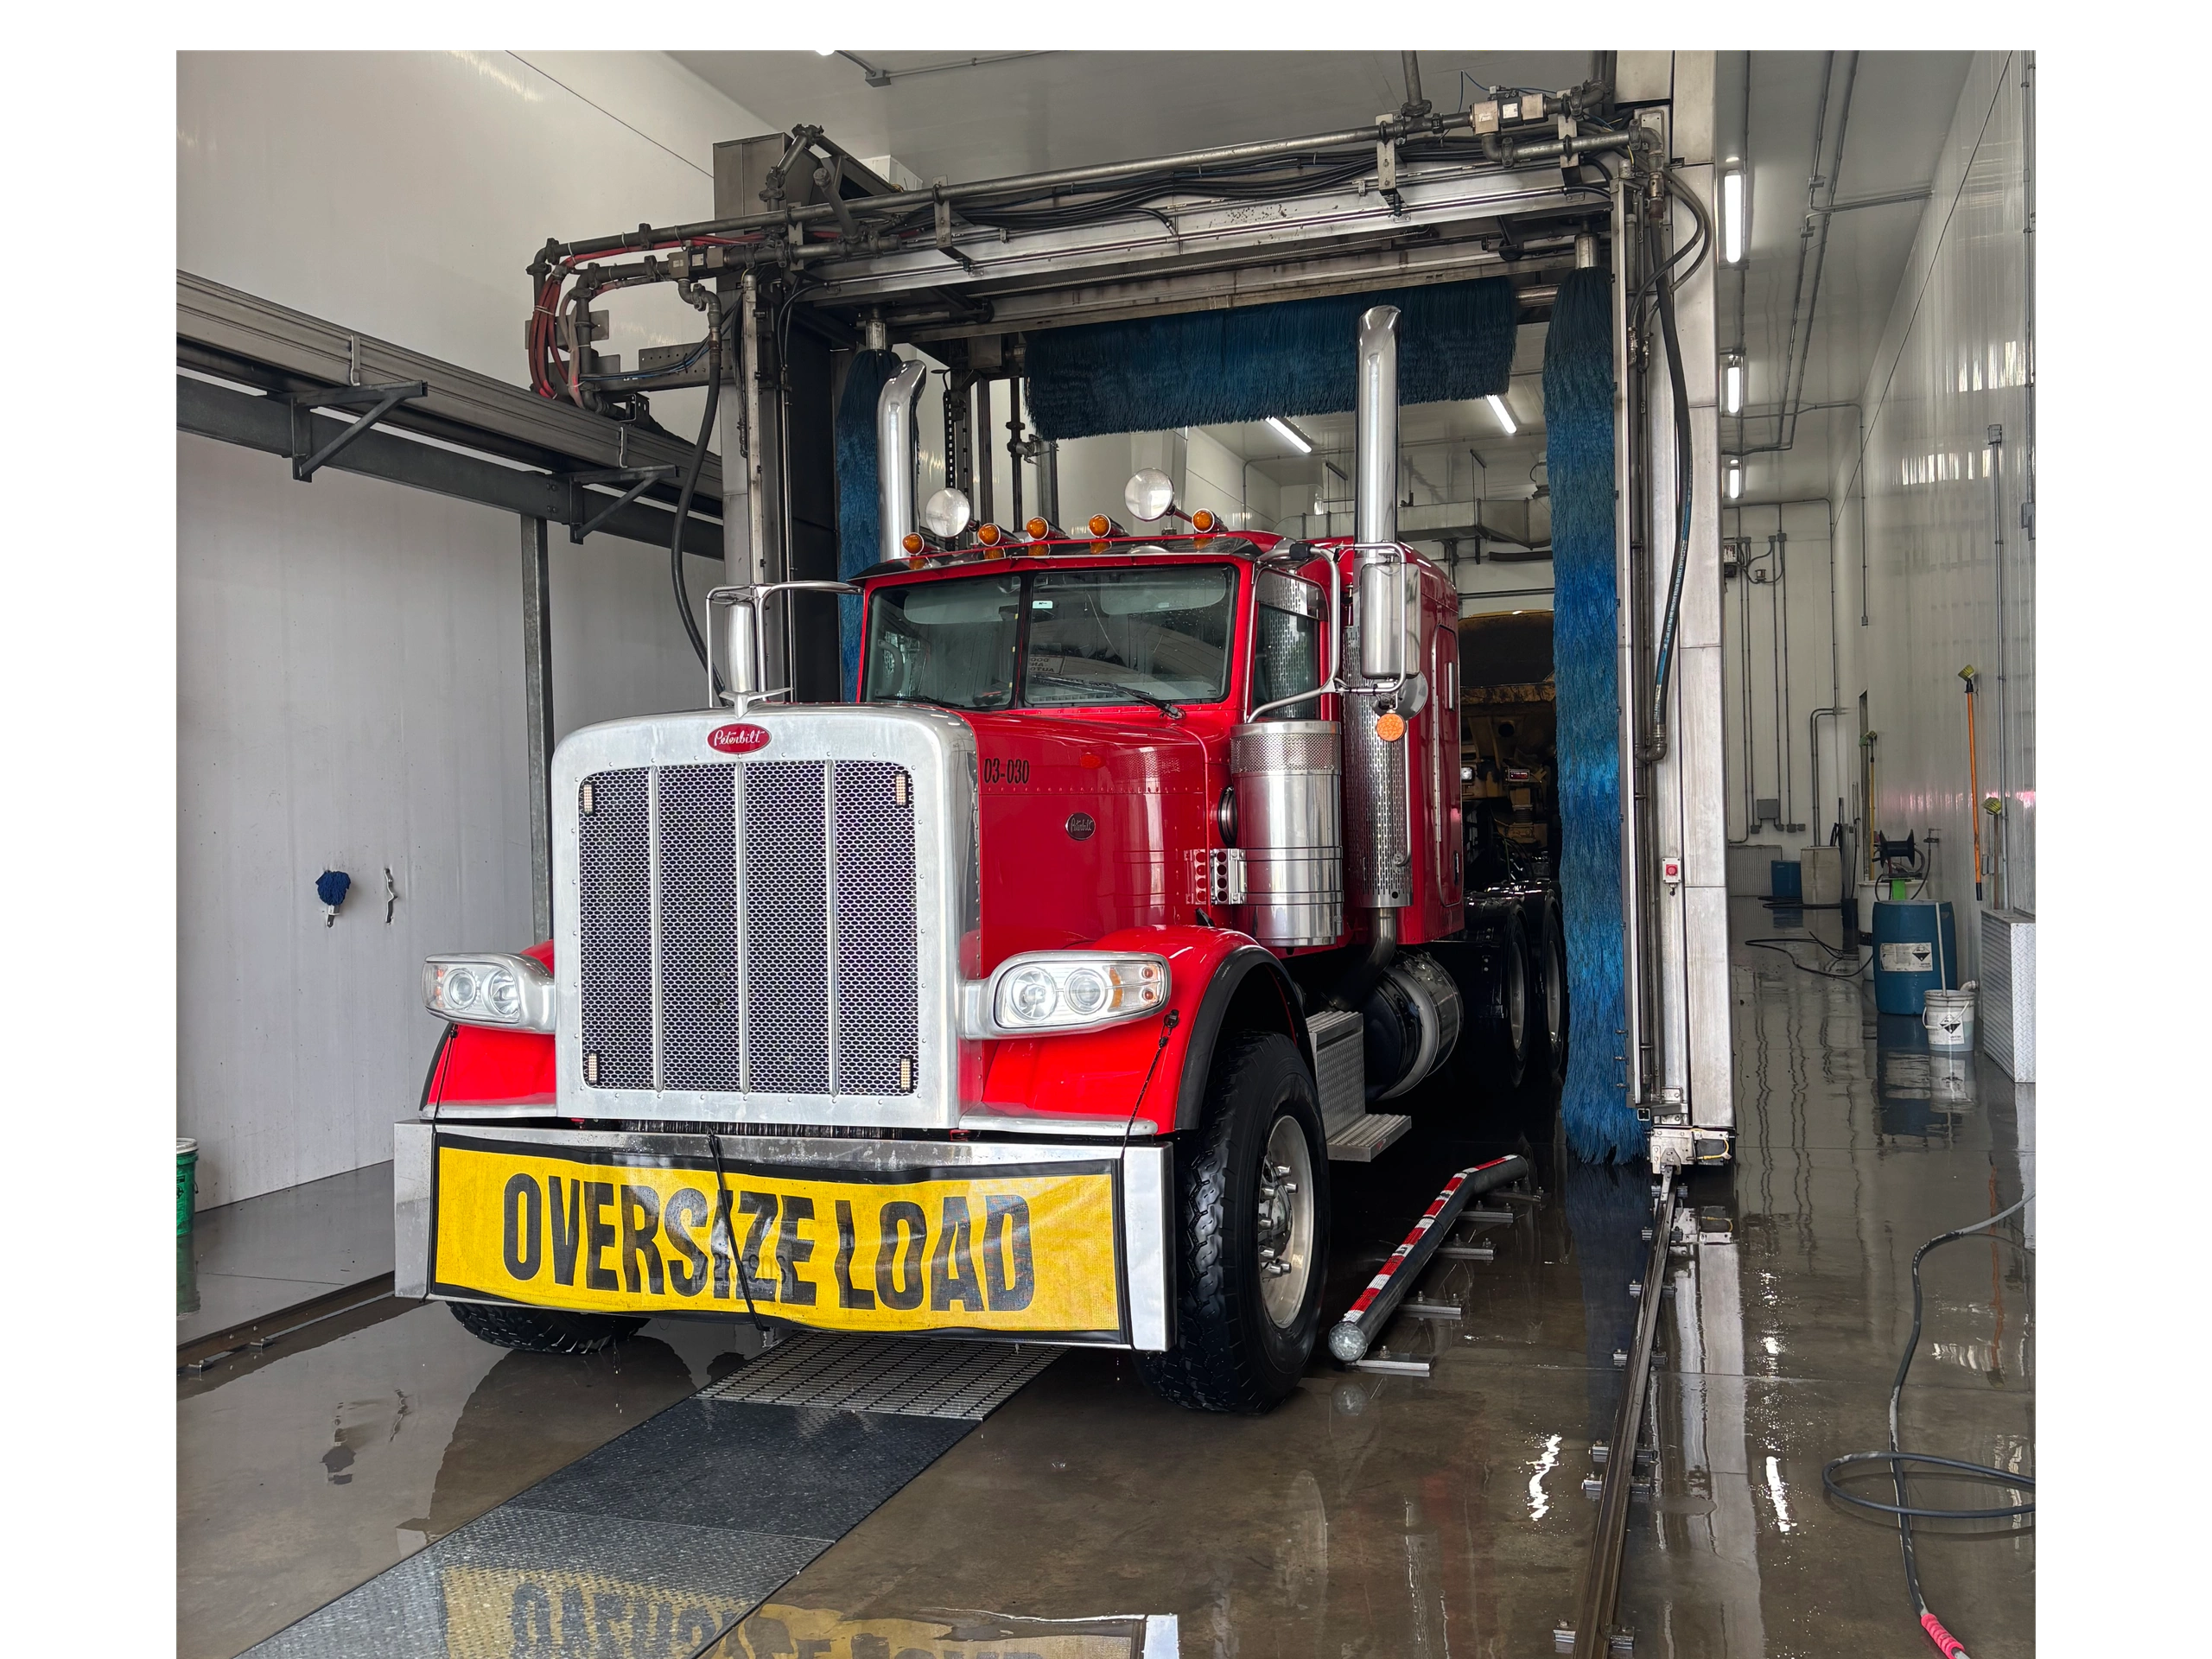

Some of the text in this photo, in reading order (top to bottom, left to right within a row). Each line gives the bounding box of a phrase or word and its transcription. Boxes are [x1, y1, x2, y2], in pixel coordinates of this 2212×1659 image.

[714, 729, 765, 747] Peterbilt
[983, 758, 1030, 785] 03-030
[1070, 818, 1093, 833] Peterbilt
[503, 1173, 1035, 1312] OVERSIZE LOAD
